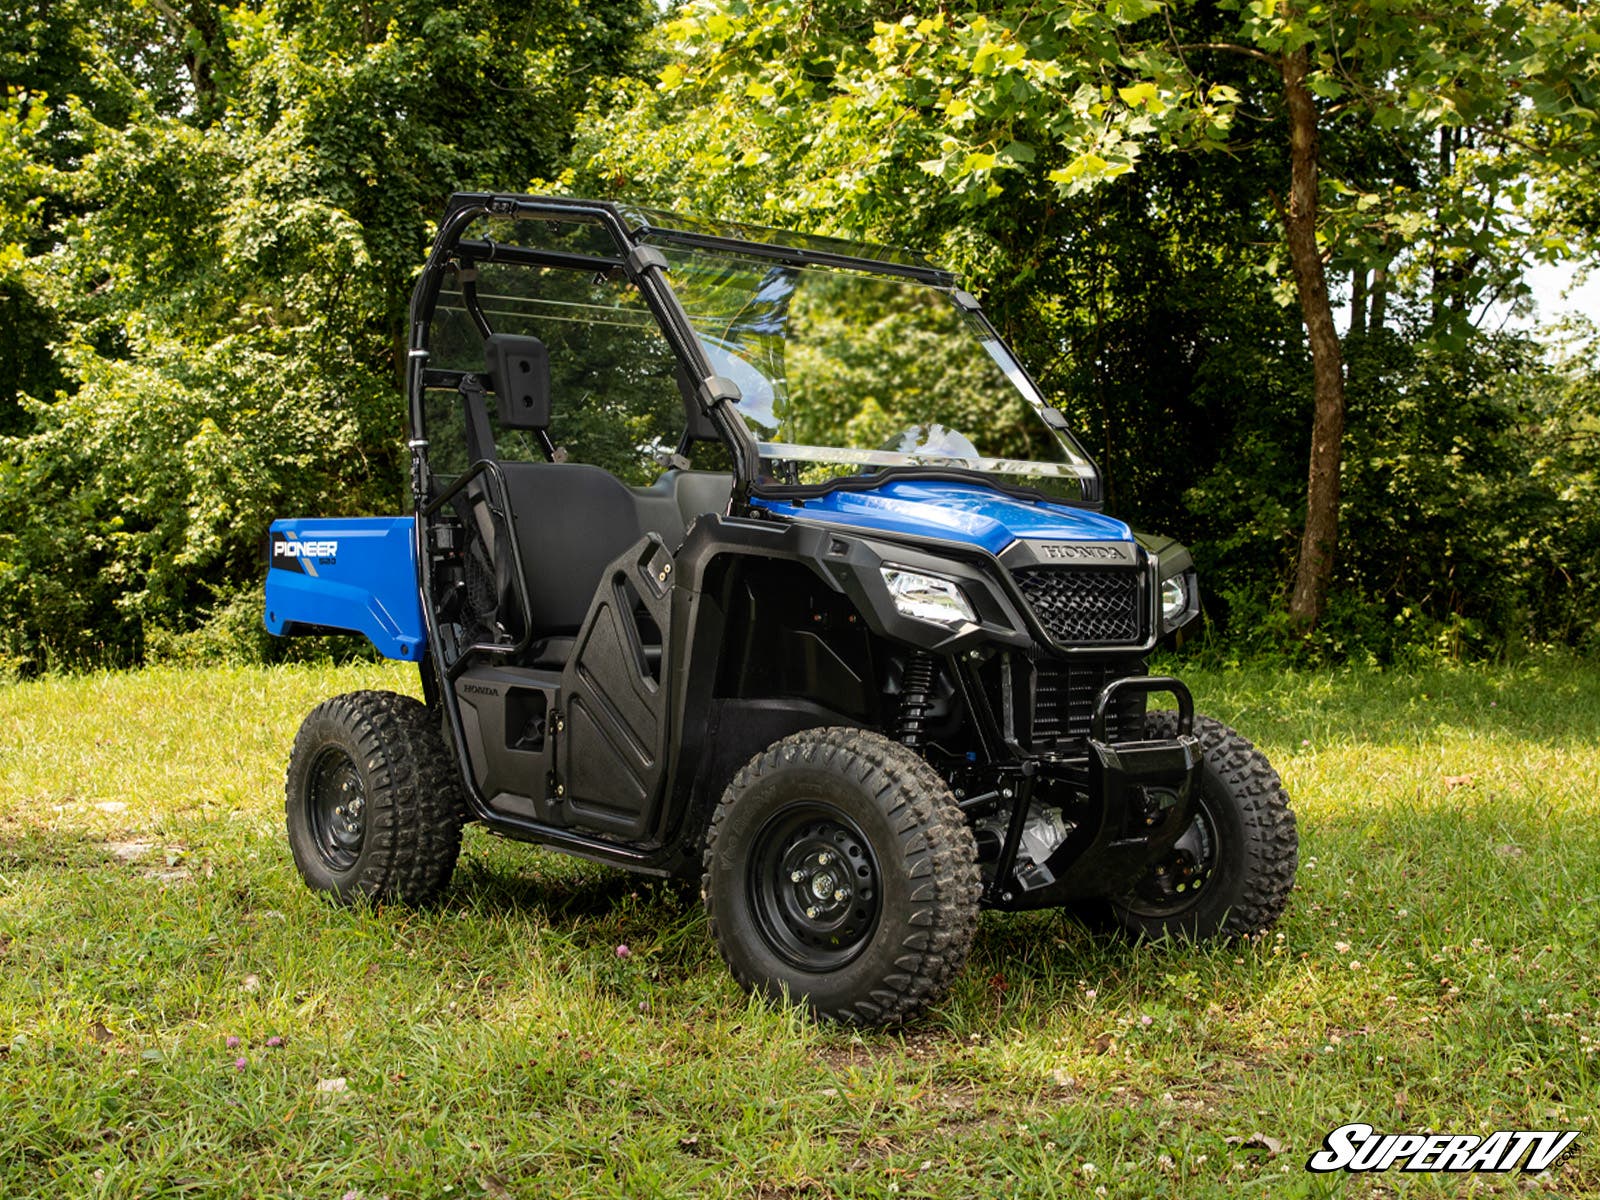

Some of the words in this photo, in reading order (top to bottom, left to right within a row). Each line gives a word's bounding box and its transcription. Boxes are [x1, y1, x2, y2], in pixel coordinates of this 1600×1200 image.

[274, 541, 338, 557] PIONEER
[1041, 545, 1127, 560] HONDA
[463, 684, 499, 696] HONDA
